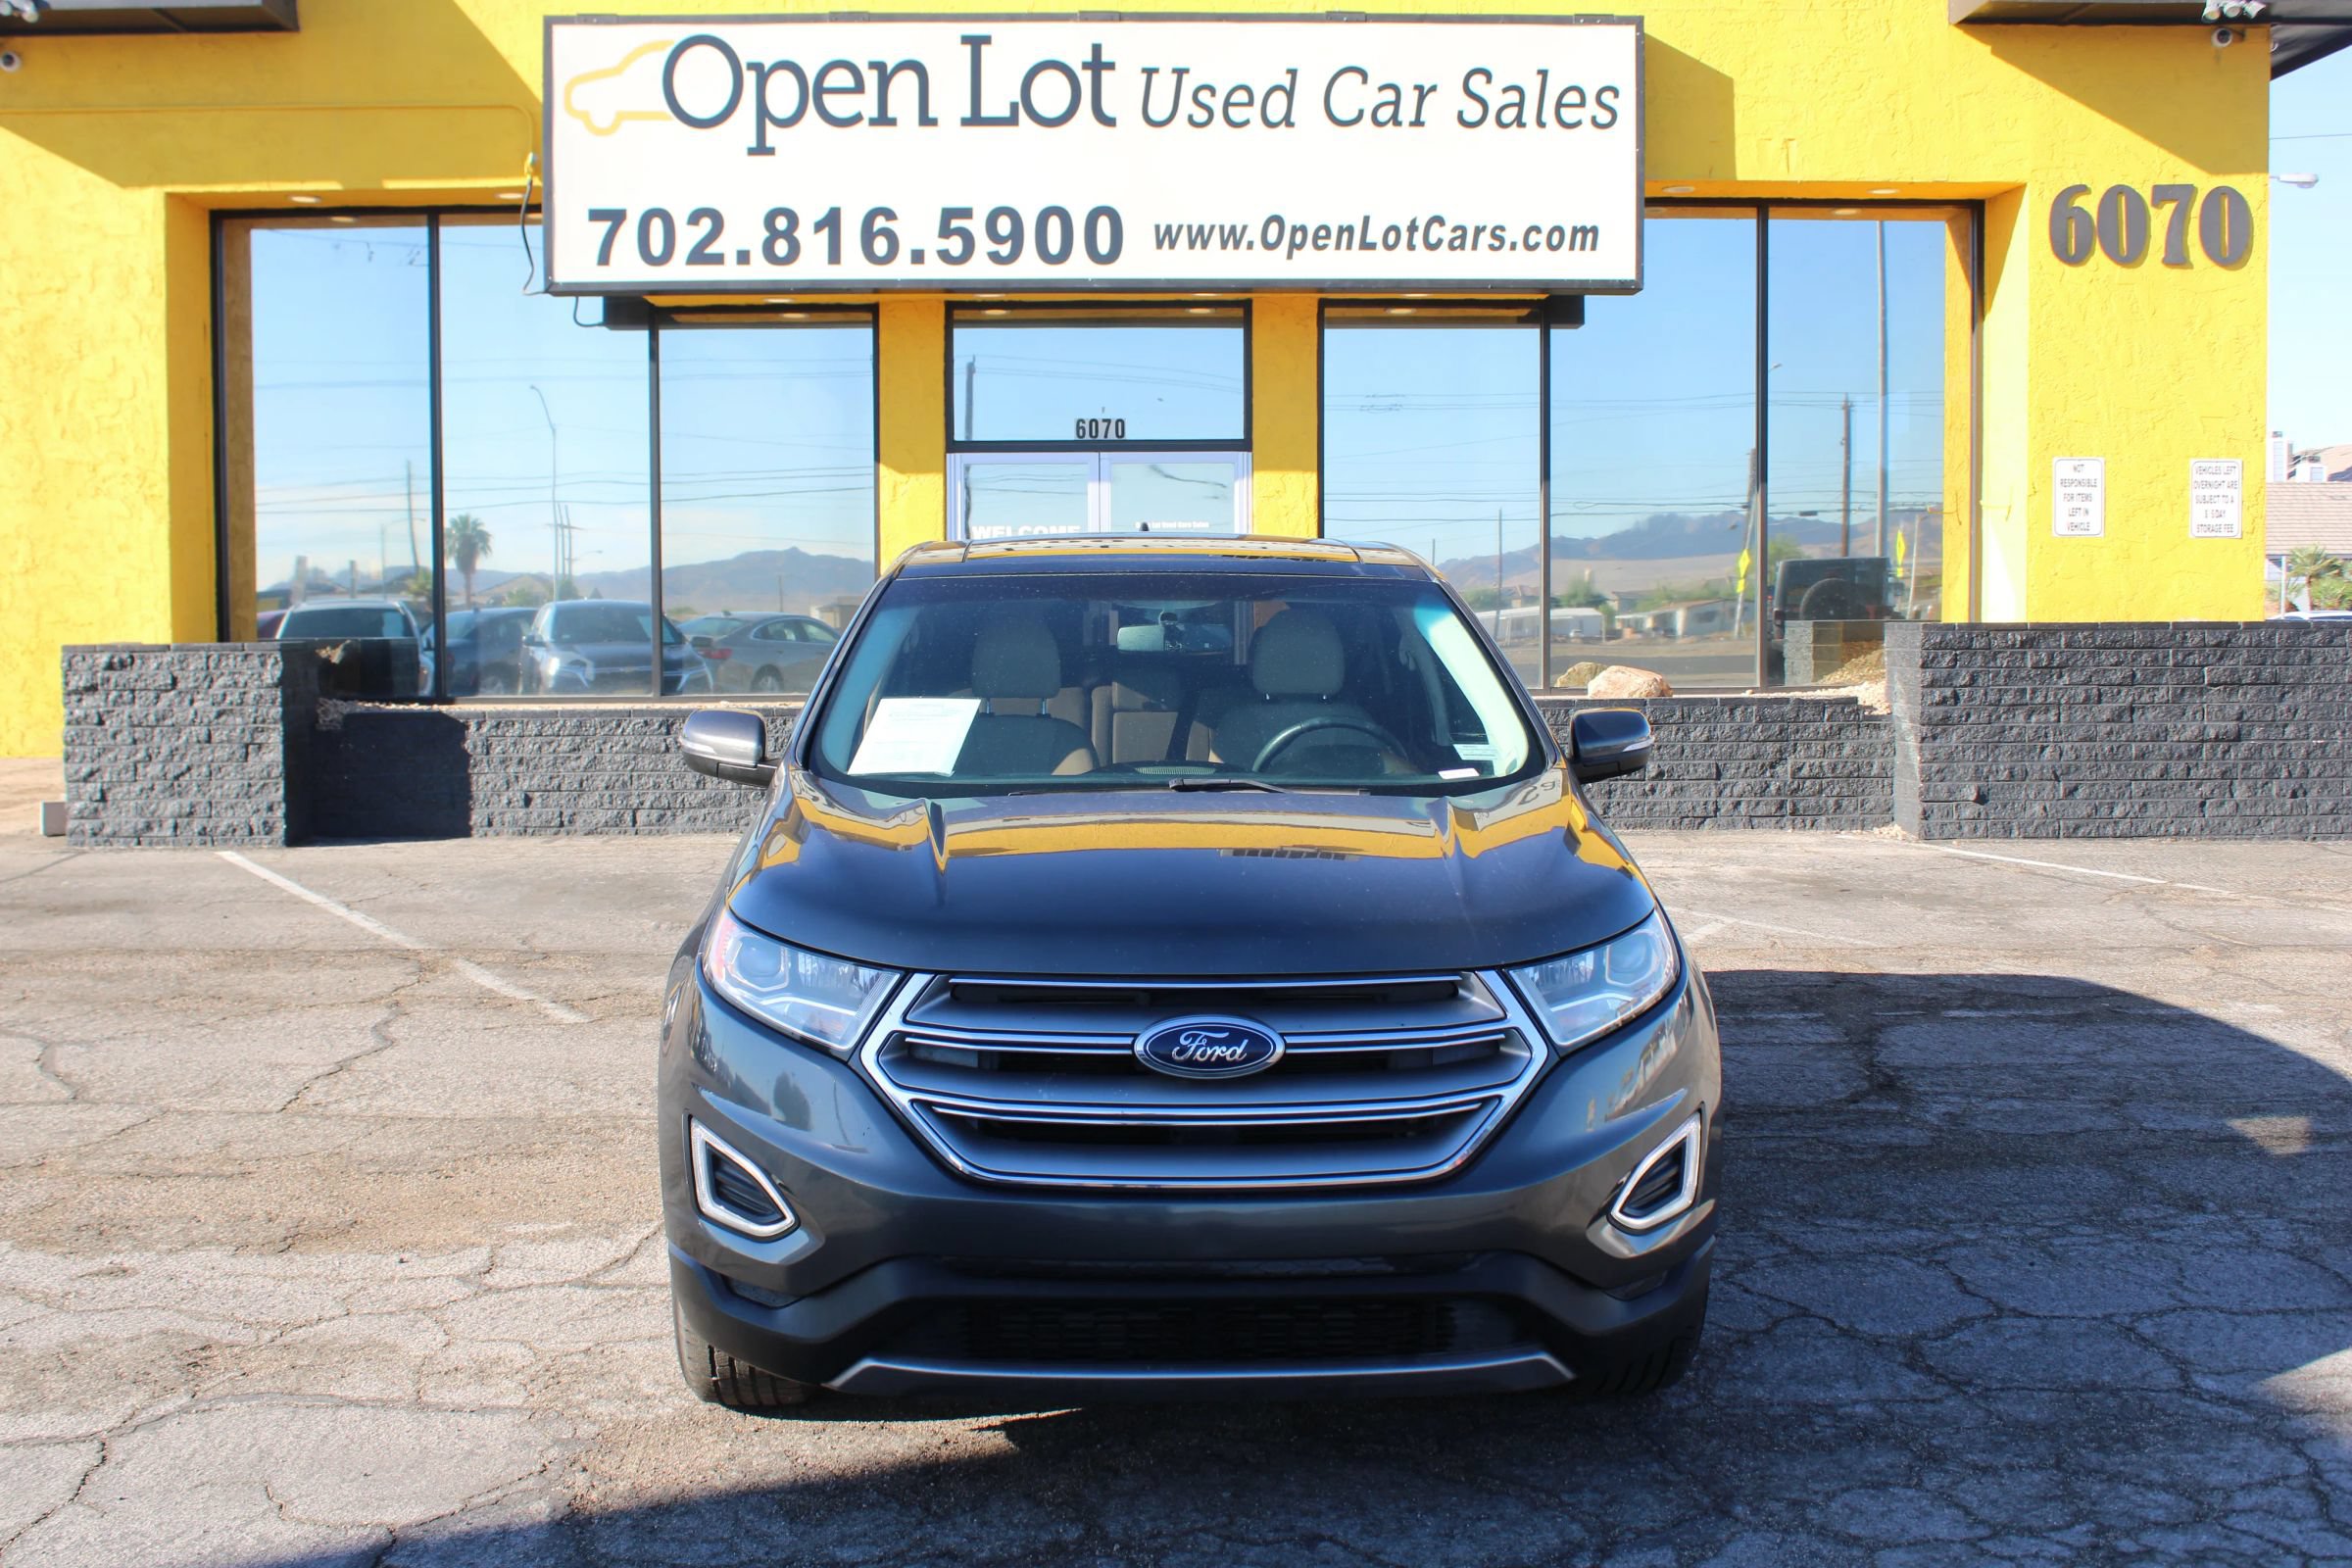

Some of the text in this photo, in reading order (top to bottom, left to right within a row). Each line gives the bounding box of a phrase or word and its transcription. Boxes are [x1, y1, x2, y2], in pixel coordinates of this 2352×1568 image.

[662, 34, 1621, 156] Open Lot Used Car Sales
[2049, 184, 2252, 267] 6070
[588, 205, 1124, 267] 702.816.5900
[1153, 214, 1599, 261] www.OpenLotCars.com
[1075, 417, 1126, 440] 6070
[2223, 466, 2237, 475] LEFT
[2059, 477, 2098, 488] RESPONSIBLE
[2193, 479, 2226, 490] OVERNIGHT
[2063, 492, 2093, 503] FOR ITEMS
[2195, 494, 2220, 505] SUBJECT
[2068, 507, 2082, 517] LEFT
[2066, 521, 2091, 532] VEHICLE
[2196, 523, 2235, 534] STORAGE FEE
[1171, 1030, 1250, 1062] Ford
